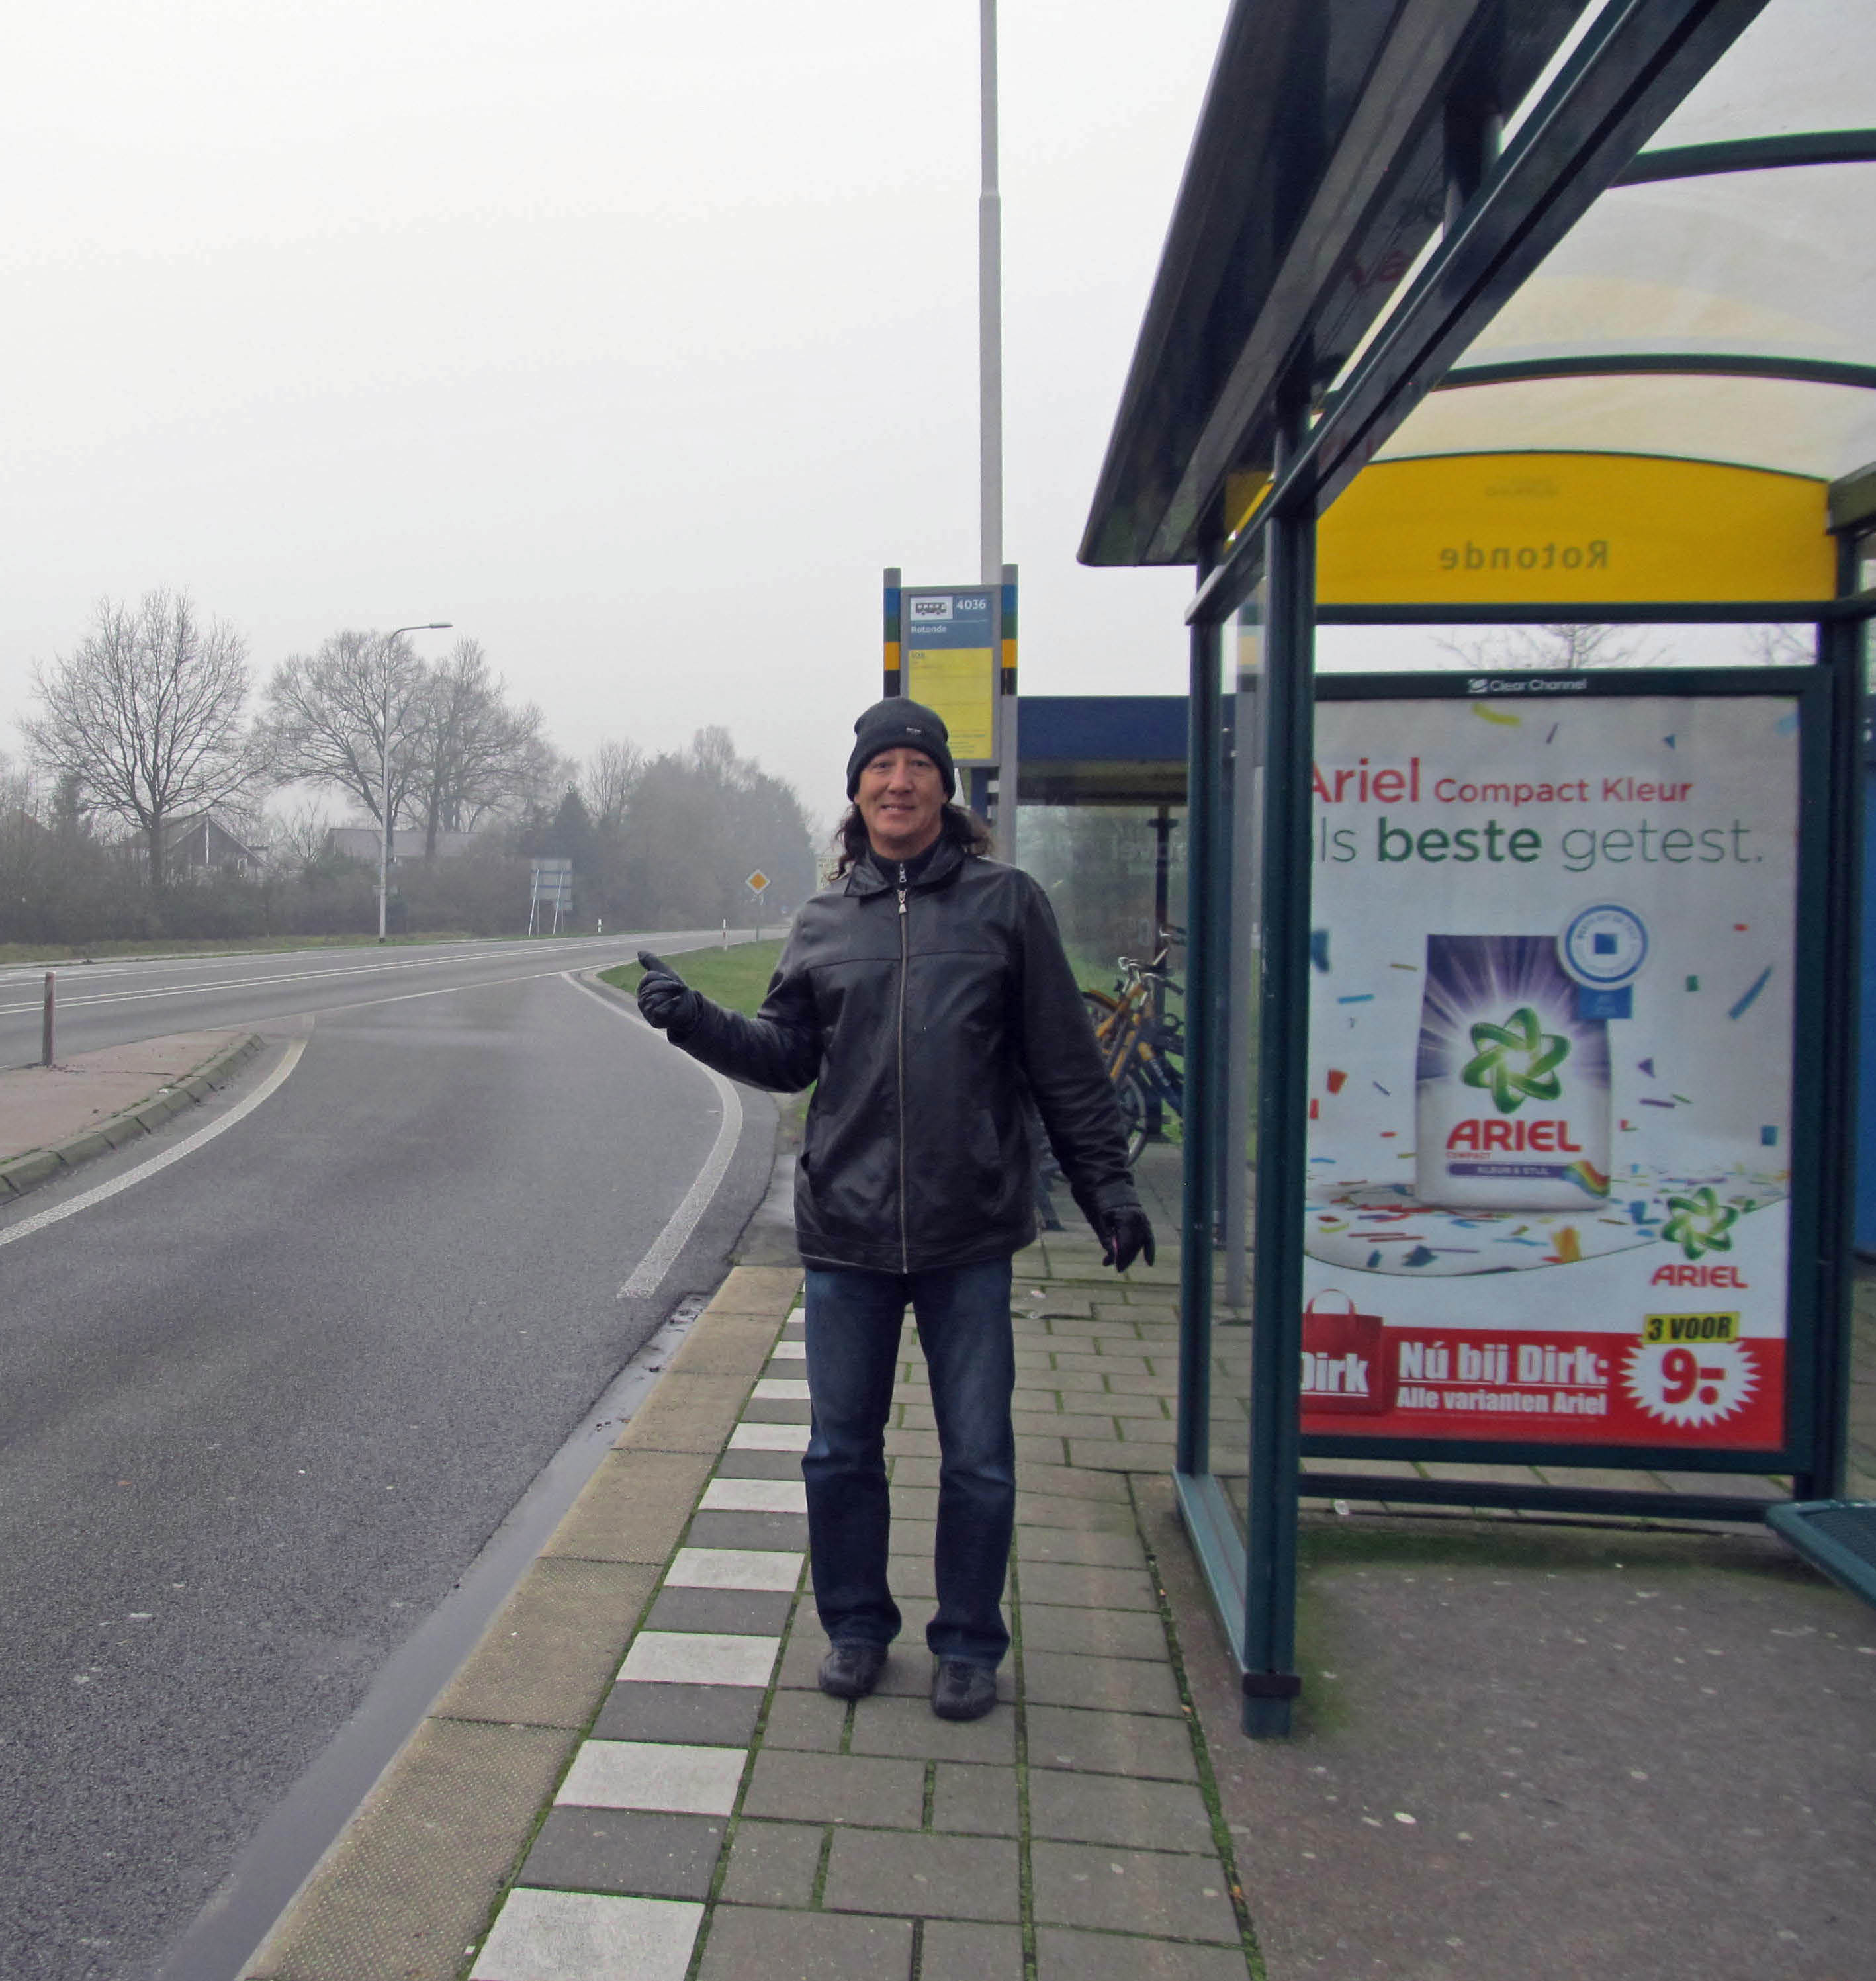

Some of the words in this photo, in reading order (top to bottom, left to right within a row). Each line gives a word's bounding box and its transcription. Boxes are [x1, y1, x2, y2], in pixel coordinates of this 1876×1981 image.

[956, 599, 987, 609] 4036
[911, 625, 947, 633] Rotonde
[1490, 680, 1525, 691] Clear
[1529, 678, 1587, 690] Channel
[1434, 777, 1591, 806] Compact
[1601, 777, 1693, 803] Kleur
[1378, 816, 1542, 862] beste
[1562, 818, 1763, 872] getest.
[1447, 1119, 1583, 1152] ARIEL
[1650, 1264, 1750, 1288] ARIEL
[1648, 1318, 1664, 1341] 3
[1670, 1316, 1732, 1339] VOOR
[1398, 1341, 1449, 1380] Nú
[1458, 1343, 1509, 1384] bij
[1517, 1344, 1609, 1384] Dirk:
[1397, 1387, 1439, 1409] Alle
[1444, 1390, 1549, 1413] varianten
[1552, 1393, 1607, 1415] Ariel
